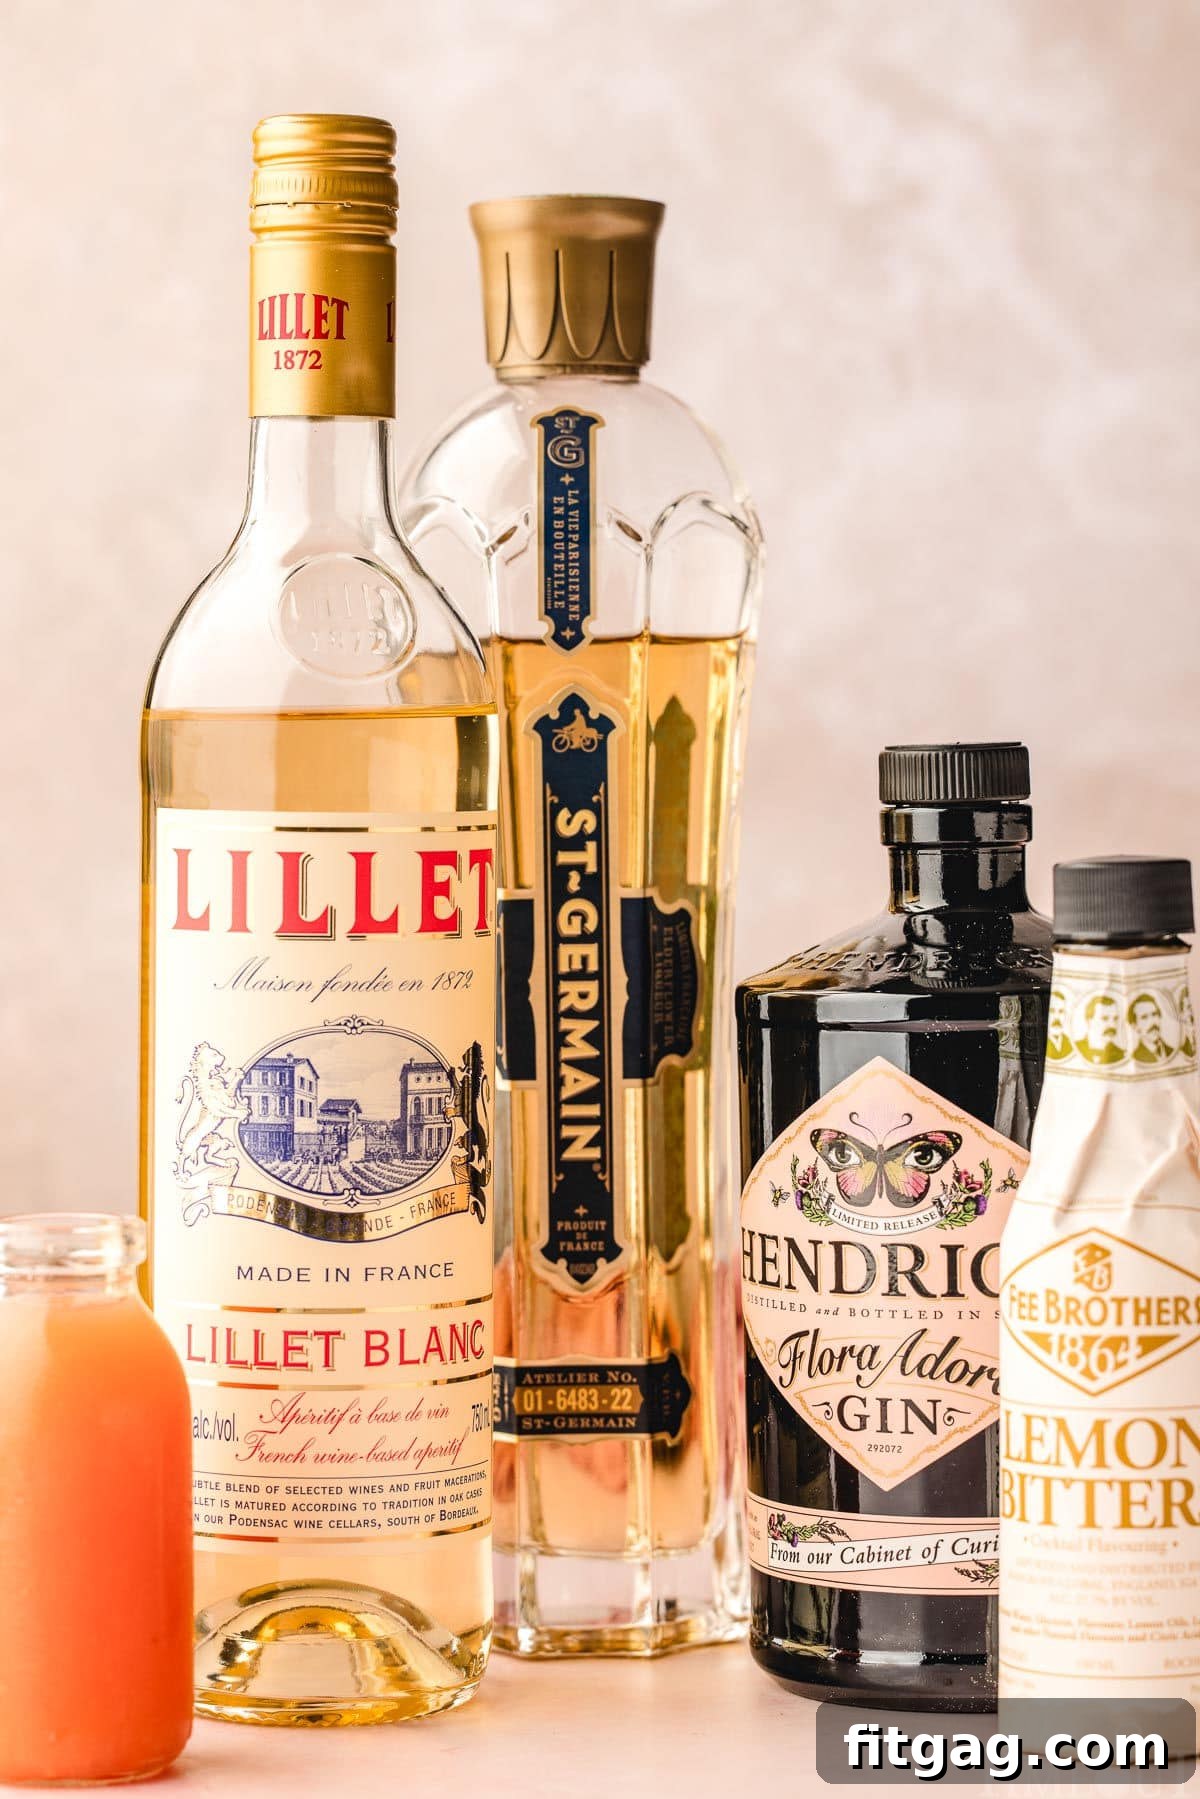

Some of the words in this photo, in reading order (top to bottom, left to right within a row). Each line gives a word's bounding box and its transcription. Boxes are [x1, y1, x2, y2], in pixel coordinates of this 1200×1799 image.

[257, 293, 349, 340] LILLET
[273, 349, 322, 370] 1872
[553, 496, 566, 515] EN
[567, 490, 580, 506] LA
[567, 508, 580, 531] VIE
[553, 519, 566, 609] BOUTEILLE
[567, 534, 580, 621] PARISIENNE
[172, 848, 494, 941] LILLET
[213, 955, 313, 993] Maison
[310, 963, 393, 1003] fondée
[398, 977, 424, 993] en
[431, 968, 474, 993] 1872
[410, 1193, 457, 1220] FRANCE
[832, 1207, 879, 1231] LIMITED
[883, 1211, 938, 1231] RELEASE
[557, 1220, 607, 1231] PRODUIT
[559, 1241, 605, 1251] FRANCE
[236, 1265, 311, 1283] MADE
[325, 1267, 350, 1282] IN
[364, 1262, 454, 1282] FRANCE
[747, 1292, 807, 1313] DISTILLED
[815, 1306, 840, 1316] and
[849, 1308, 943, 1320] BOTTLED
[958, 1310, 980, 1320] IN
[1009, 1284, 1039, 1322] FEE
[186, 1323, 345, 1371] LILLET
[364, 1319, 485, 1368] BLANC
[778, 1328, 881, 1388] Flora
[1051, 1332, 1143, 1379] 1864
[522, 1372, 599, 1385] ATELIER
[192, 1411, 239, 1442] alc./vol.
[259, 1391, 357, 1435] Apéritif
[350, 1408, 364, 1425] à
[367, 1397, 401, 1424] base
[405, 1397, 424, 1422] de
[427, 1403, 450, 1420] vin
[837, 1395, 942, 1435] GIN
[235, 1429, 313, 1464] French
[313, 1436, 417, 1464] wine-based
[413, 1425, 469, 1470] aperitif
[867, 1444, 902, 1454] 292072
[1004, 1410, 1200, 1470] LEMON
[225, 1482, 260, 1494] BLEND
[265, 1484, 280, 1494] OF
[285, 1485, 342, 1495] SELECTED
[349, 1484, 384, 1494] WINES
[389, 1482, 409, 1493] AND
[414, 1479, 440, 1491] FRUIT
[444, 1469, 487, 1487] MACERATIONS,
[220, 1498, 230, 1508] IS
[234, 1499, 286, 1511] MATURED
[292, 1502, 357, 1512] ACCORDING
[363, 1501, 377, 1511] TO
[382, 1497, 434, 1510] TRADITION
[438, 1495, 447, 1505] IN
[450, 1493, 464, 1503] OAK
[466, 1487, 483, 1501] CASKS
[1001, 1468, 1200, 1529] BITTER
[204, 1514, 223, 1525] OUR
[294, 1518, 323, 1529] WINE
[328, 1518, 382, 1530] CELLARS,
[387, 1515, 420, 1527] SOUTH
[425, 1512, 435, 1523] OF
[770, 1542, 800, 1563] From
[807, 1551, 832, 1565] our
[840, 1545, 912, 1565] Cabinet
[921, 1539, 944, 1564] of
